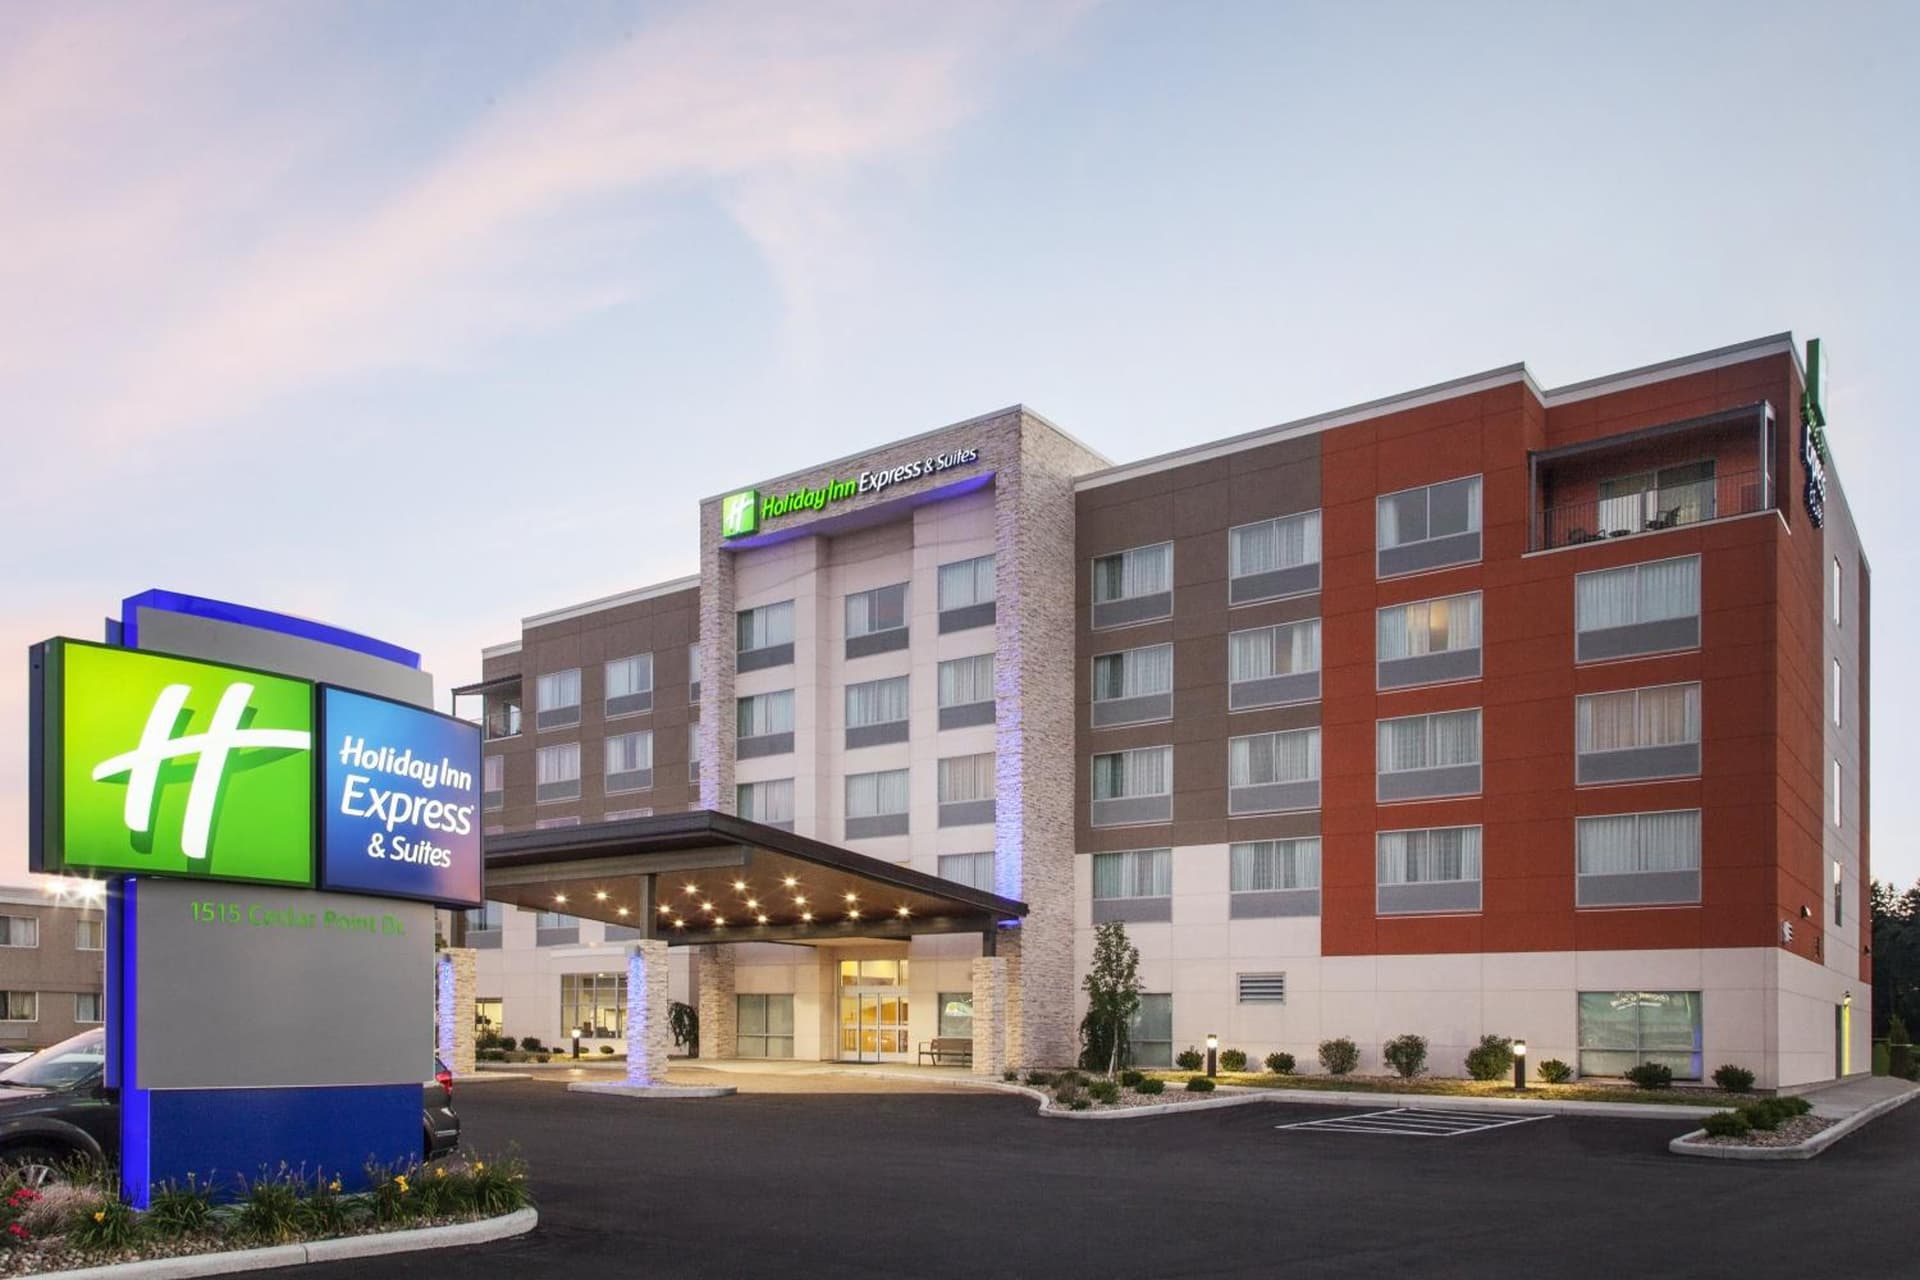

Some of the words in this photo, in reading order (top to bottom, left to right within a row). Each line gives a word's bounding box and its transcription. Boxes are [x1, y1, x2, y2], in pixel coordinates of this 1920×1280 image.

[761, 488, 826, 520] Holiday
[828, 478, 857, 501] Inn
[858, 461, 921, 492] Express
[923, 457, 934, 473] &
[936, 448, 977, 471] Suites
[339, 735, 439, 788] Holiday
[440, 757, 471, 792] Inn
[340, 774, 474, 835] Express
[367, 832, 385, 859] &
[390, 835, 451, 868] Suites
[191, 901, 241, 922] 1515
[323, 909, 375, 933] Point
